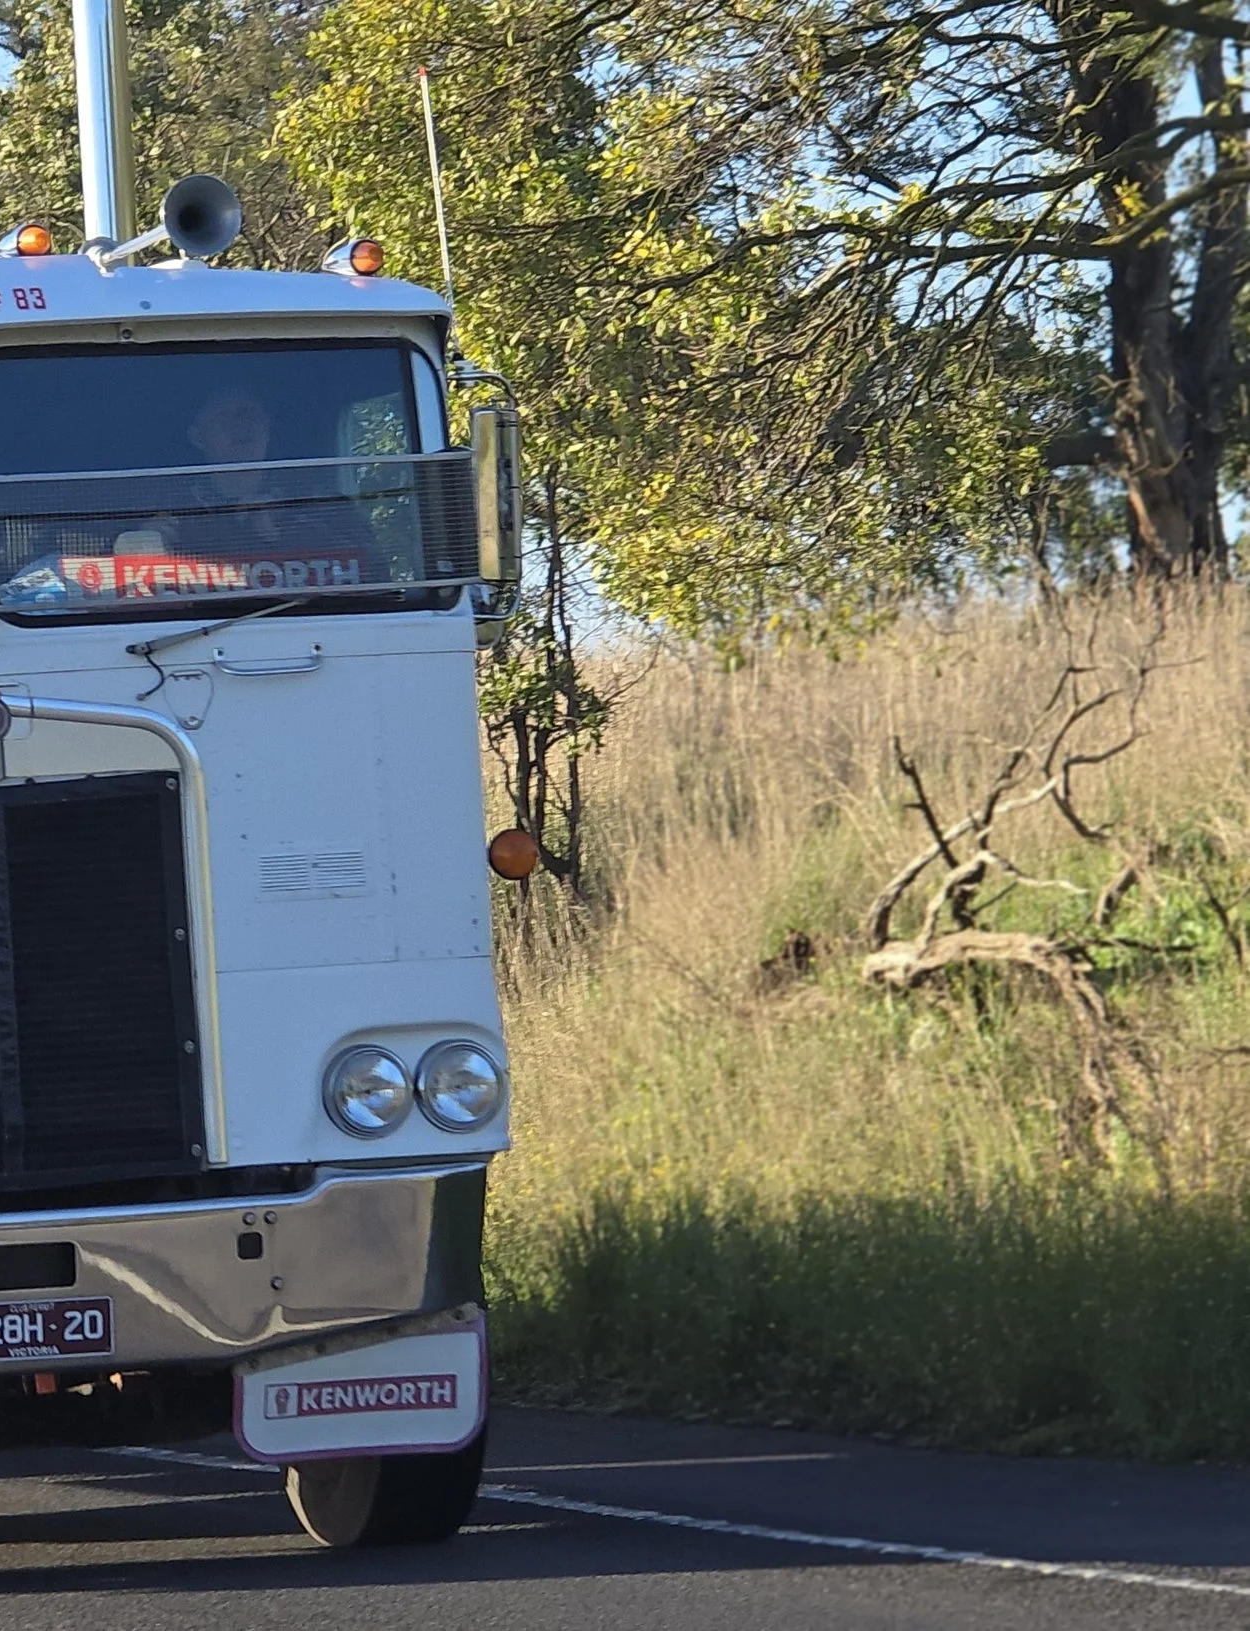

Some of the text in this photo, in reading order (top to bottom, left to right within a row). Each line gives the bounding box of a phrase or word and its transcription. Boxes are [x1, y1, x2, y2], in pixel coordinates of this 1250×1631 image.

[12, 287, 47, 310] 83
[122, 558, 360, 598] KENWORTH
[301, 1380, 451, 1411] KENWORTH
